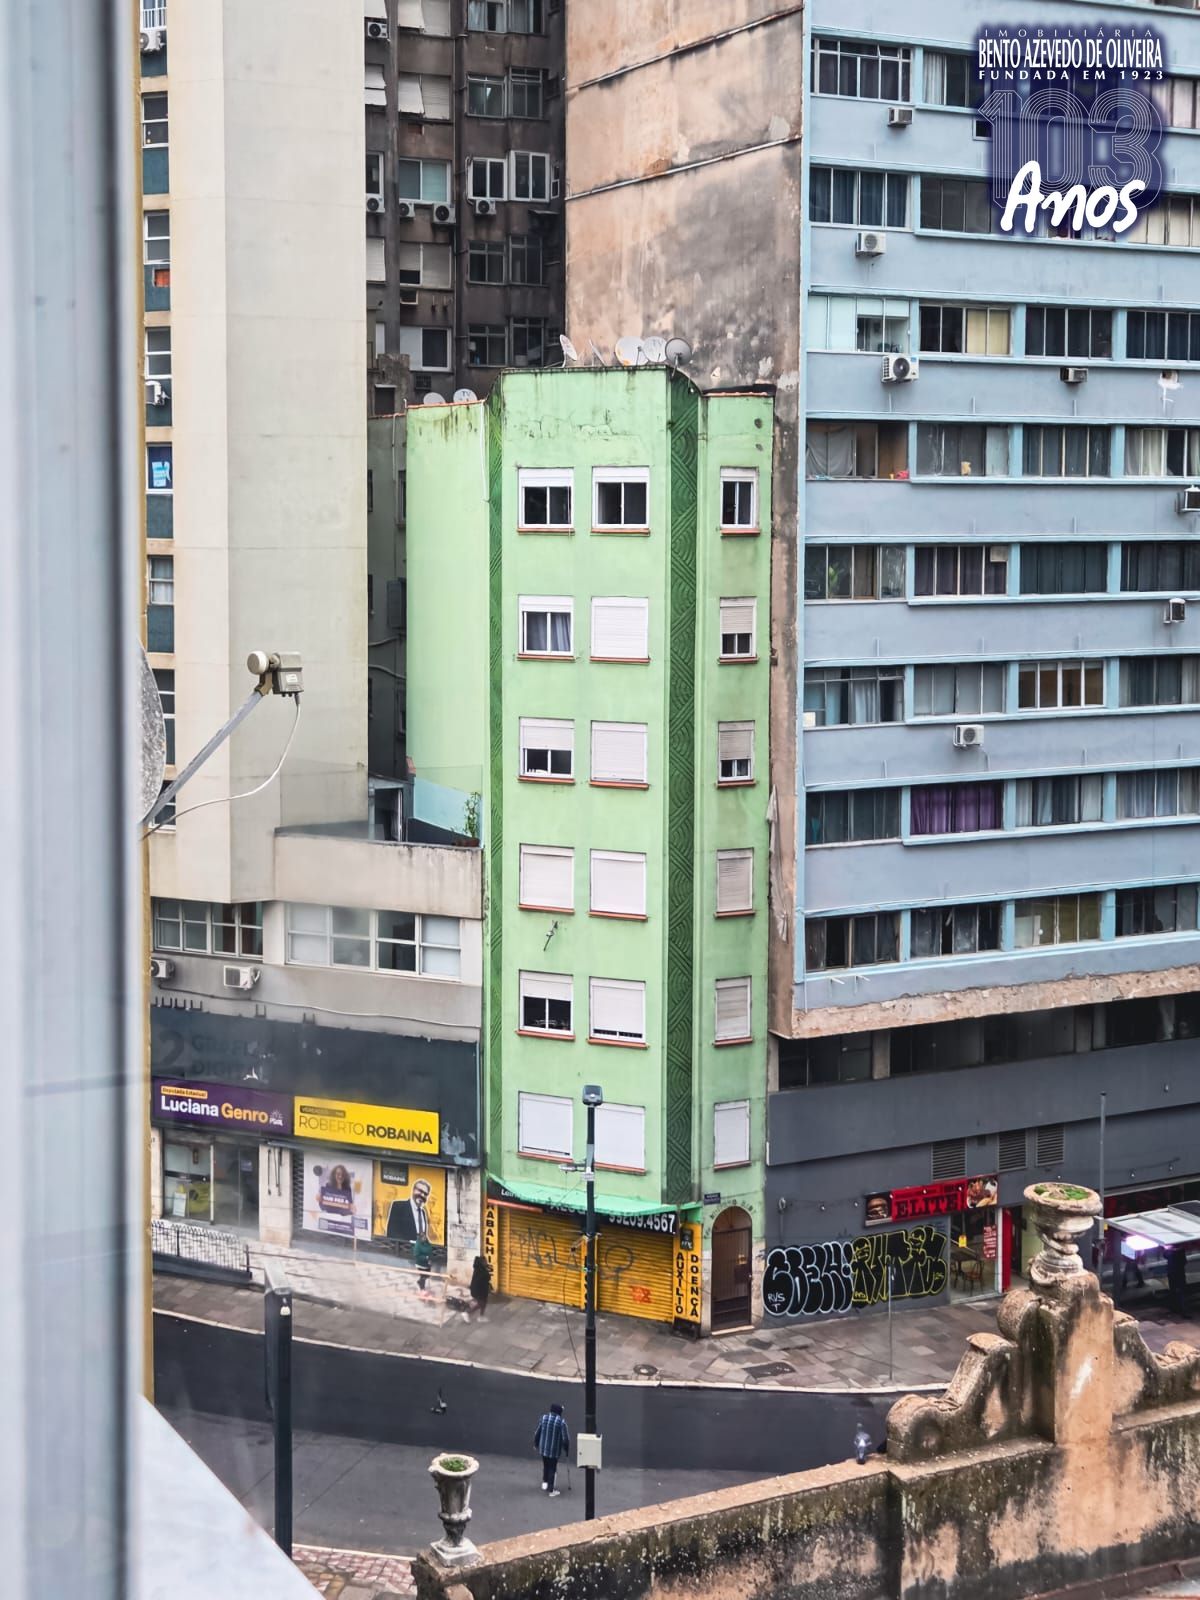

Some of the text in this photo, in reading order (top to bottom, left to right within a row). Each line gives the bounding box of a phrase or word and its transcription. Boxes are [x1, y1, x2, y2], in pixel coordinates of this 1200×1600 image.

[161, 1095, 219, 1117] Luciana
[221, 1102, 269, 1124] Genro
[299, 1115, 433, 1145] ROBERTO ROBAINA
